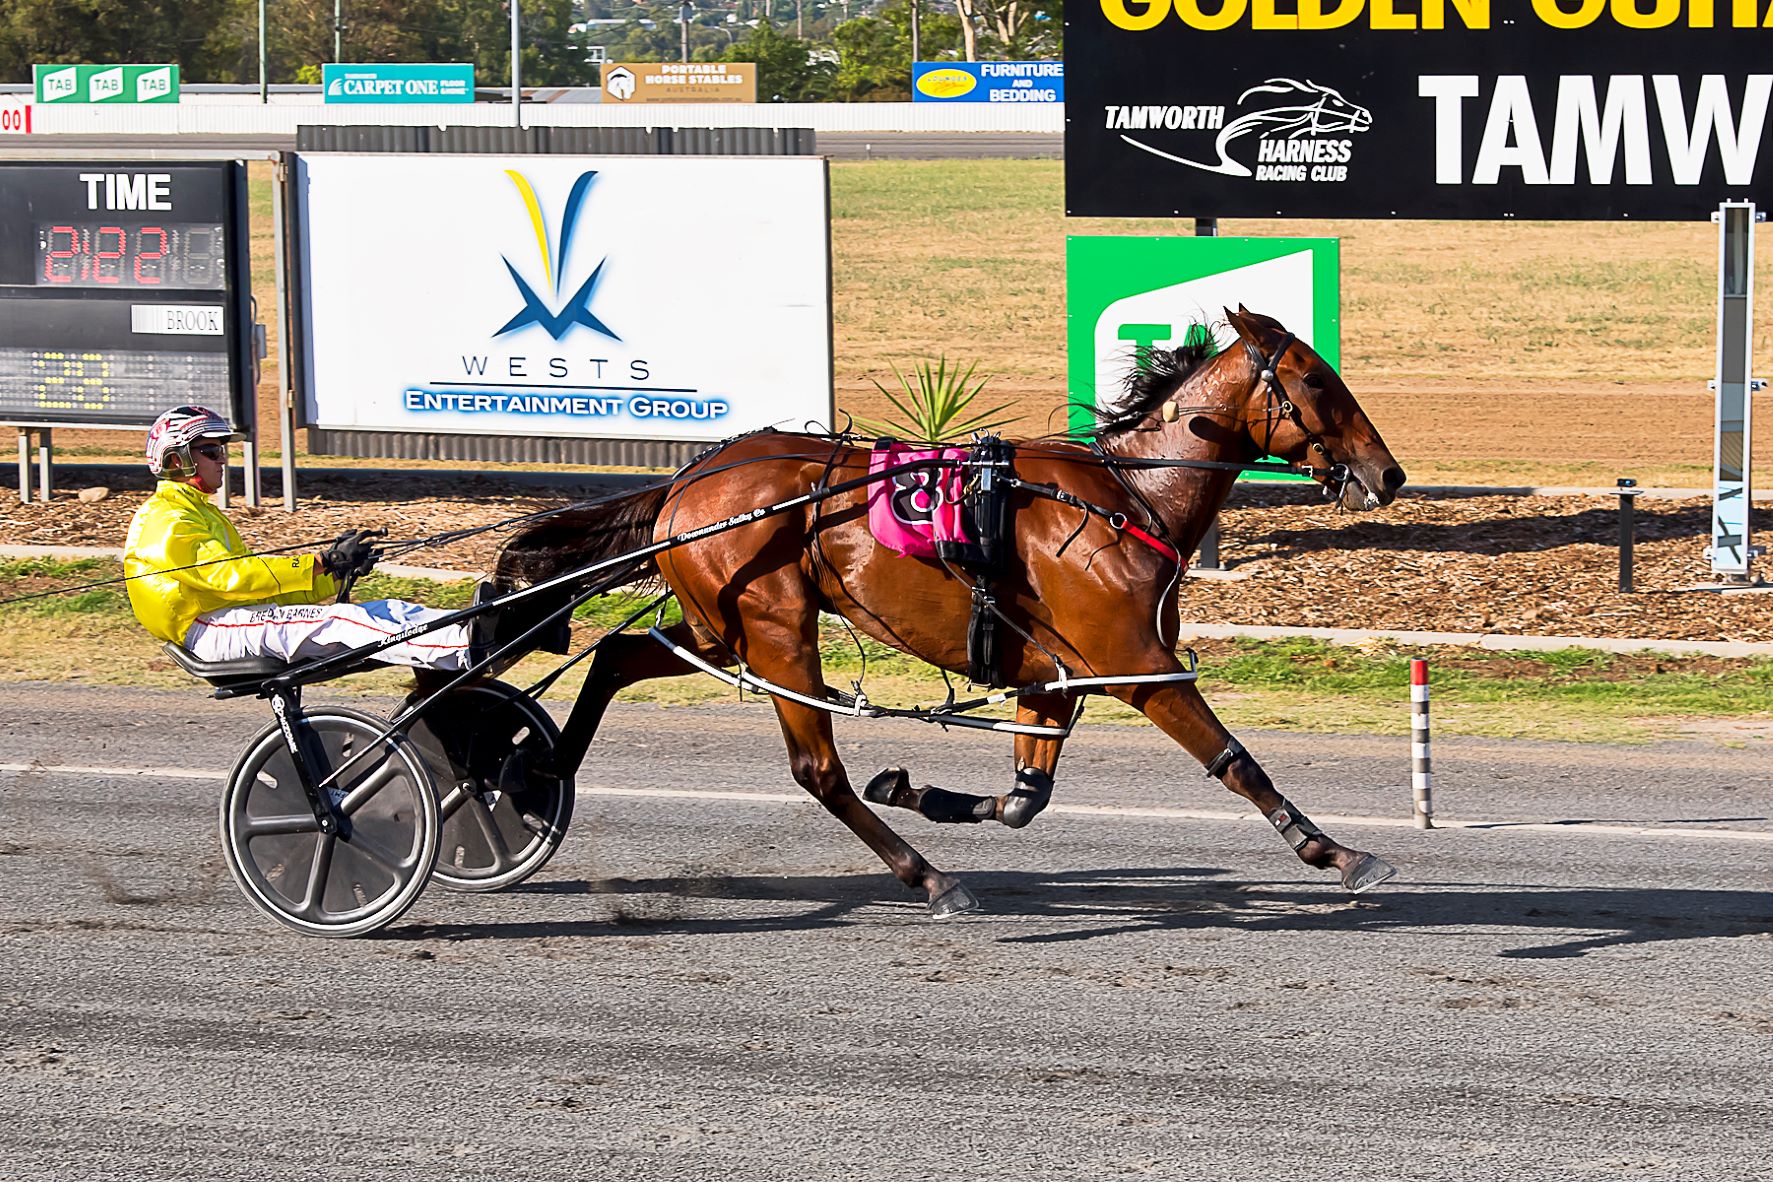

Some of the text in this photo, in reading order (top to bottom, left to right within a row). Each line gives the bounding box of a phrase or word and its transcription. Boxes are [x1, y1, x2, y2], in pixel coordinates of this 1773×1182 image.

[662, 64, 727, 74] PORTABLE
[980, 63, 1064, 77] FURNITURE
[48, 78, 72, 91] TAB
[94, 78, 118, 91] TAB
[141, 78, 166, 91] TAB
[645, 75, 743, 84] HORSE STABLES
[1012, 79, 1033, 88] AND
[343, 80, 404, 95] CARPET
[405, 80, 438, 95] ONE
[989, 89, 1057, 102] BEDDING
[1104, 105, 1225, 130] TAMWORTH
[1418, 74, 1773, 185] TAMW
[1257, 139, 1353, 163] HARNESS
[1255, 165, 1347, 182] RACING CLUB
[79, 173, 172, 211] TIME
[166, 310, 219, 331] BROOK
[462, 355, 650, 381] WESTS
[405, 390, 729, 420] ENTERTAINMENT GROUP
